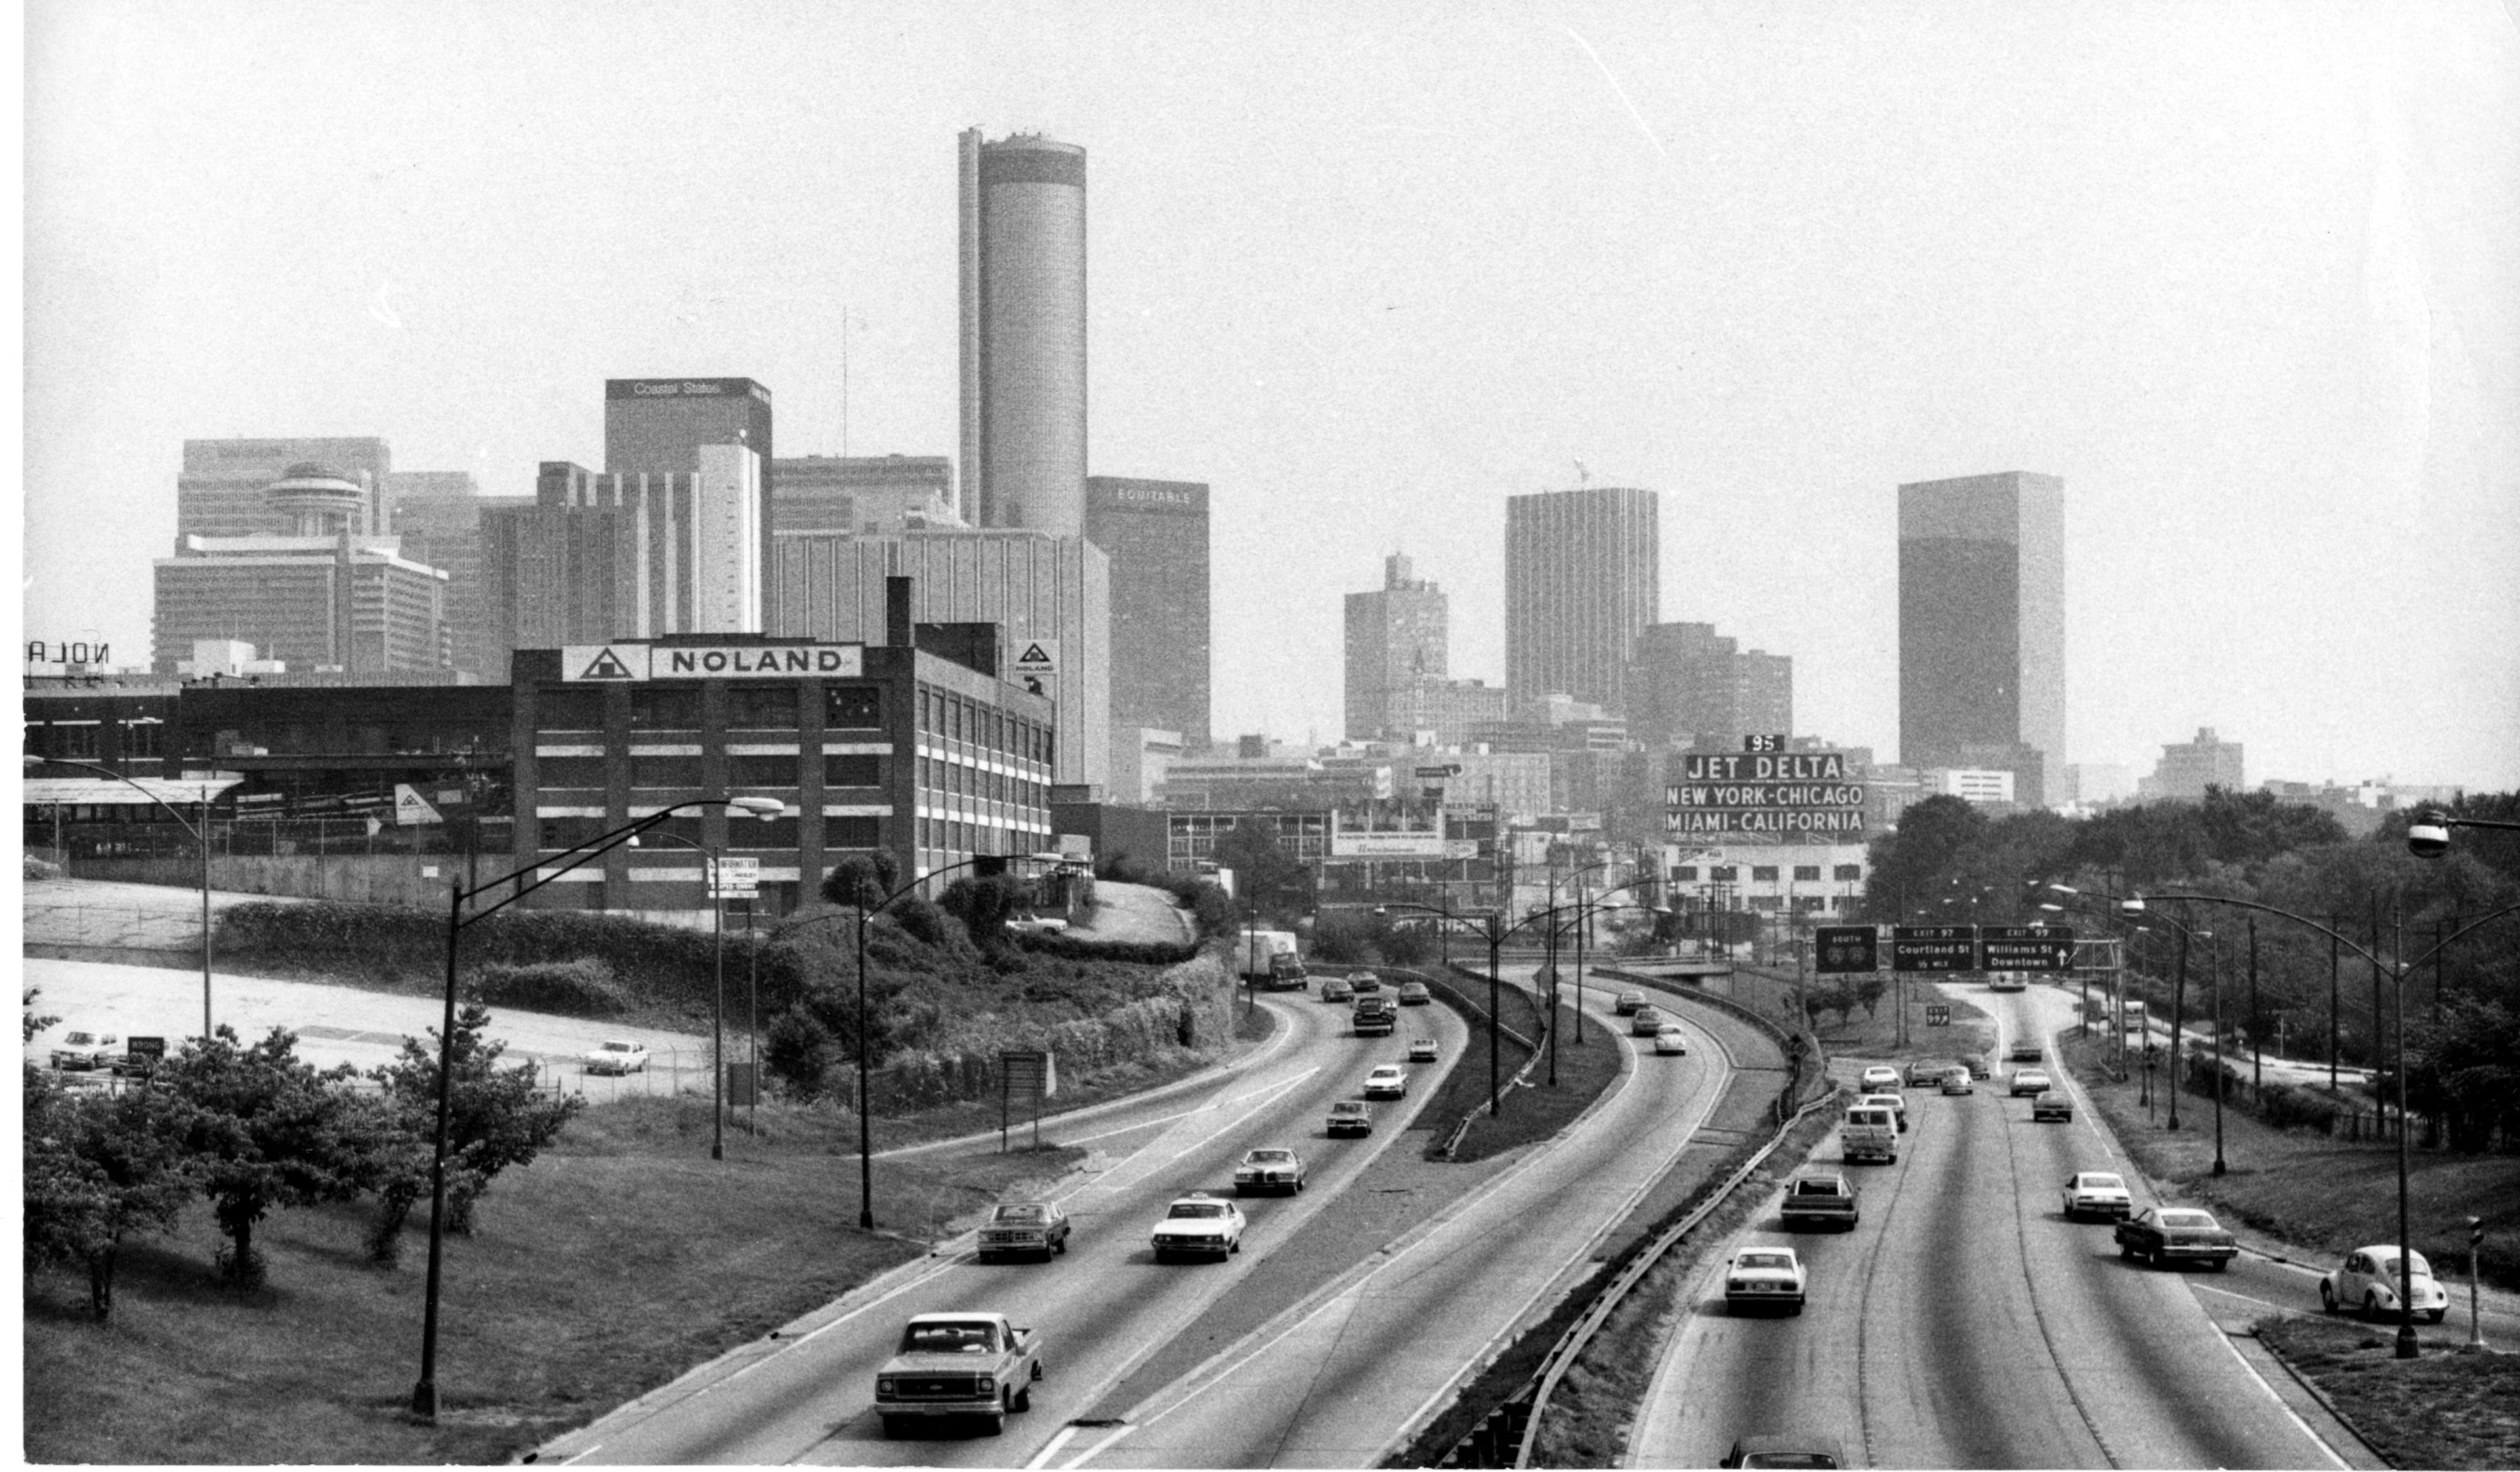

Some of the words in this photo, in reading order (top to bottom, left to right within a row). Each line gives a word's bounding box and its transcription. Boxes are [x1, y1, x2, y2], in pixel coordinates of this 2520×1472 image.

[634, 382, 677, 394] Coastal
[683, 381, 721, 394] States
[1118, 488, 1190, 504] EQUITABLE
[673, 650, 841, 672] NOLAND
[1752, 735, 1774, 751] 95
[1688, 757, 1739, 779] JET
[1756, 756, 1840, 779] DELTA
[1667, 787, 1706, 805] NEW
[1713, 787, 1862, 805] YORK-CHICAGO
[1668, 812, 1862, 831] MIAMI-CALIFORNIA
[1941, 929, 1953, 937] 97
[2035, 929, 2048, 937] 99
[1899, 945, 1954, 954] Courtland
[1958, 945, 1969, 954] St
[1987, 945, 2036, 954] Williams
[2041, 945, 2052, 954] St
[1992, 957, 2048, 966] Downtown
[1927, 1015, 1940, 1023] 99
[132, 1040, 160, 1049] WRONG
